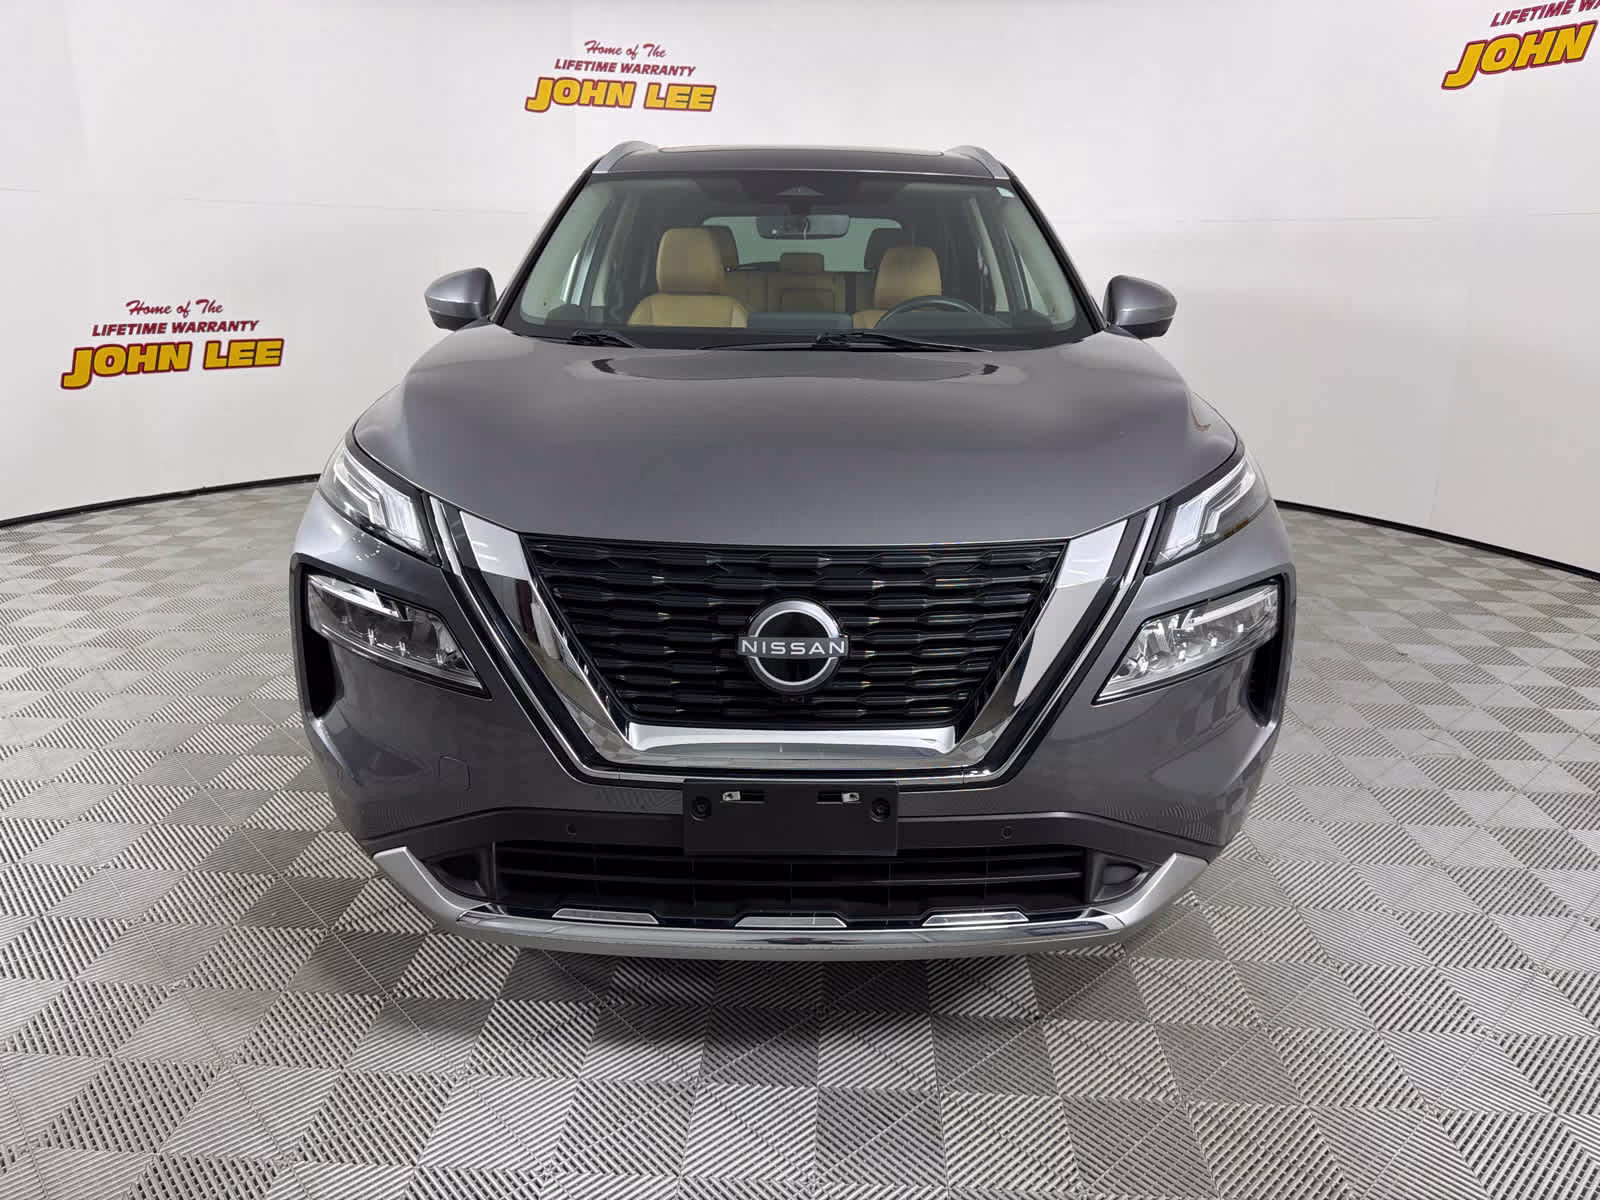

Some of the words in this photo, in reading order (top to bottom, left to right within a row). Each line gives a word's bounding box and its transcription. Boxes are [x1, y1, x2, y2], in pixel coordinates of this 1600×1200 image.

[1490, 0, 1576, 27] LIFETIME
[584, 40, 623, 56] Home
[625, 43, 639, 60] of
[642, 43, 667, 58] The
[1441, 20, 1598, 90] JOHN
[554, 58, 618, 73] LIFETIME
[620, 62, 696, 77] WARRANTY
[525, 76, 637, 113] JOHN
[643, 82, 717, 112] LEE
[125, 299, 172, 316] Home
[176, 301, 191, 318] of
[195, 298, 224, 314] The
[92, 322, 168, 337] LIFETIME
[171, 320, 260, 334] WARRANTY
[60, 341, 193, 390] JOHN
[202, 338, 285, 370] LEE
[741, 639, 845, 655] NISSAN
